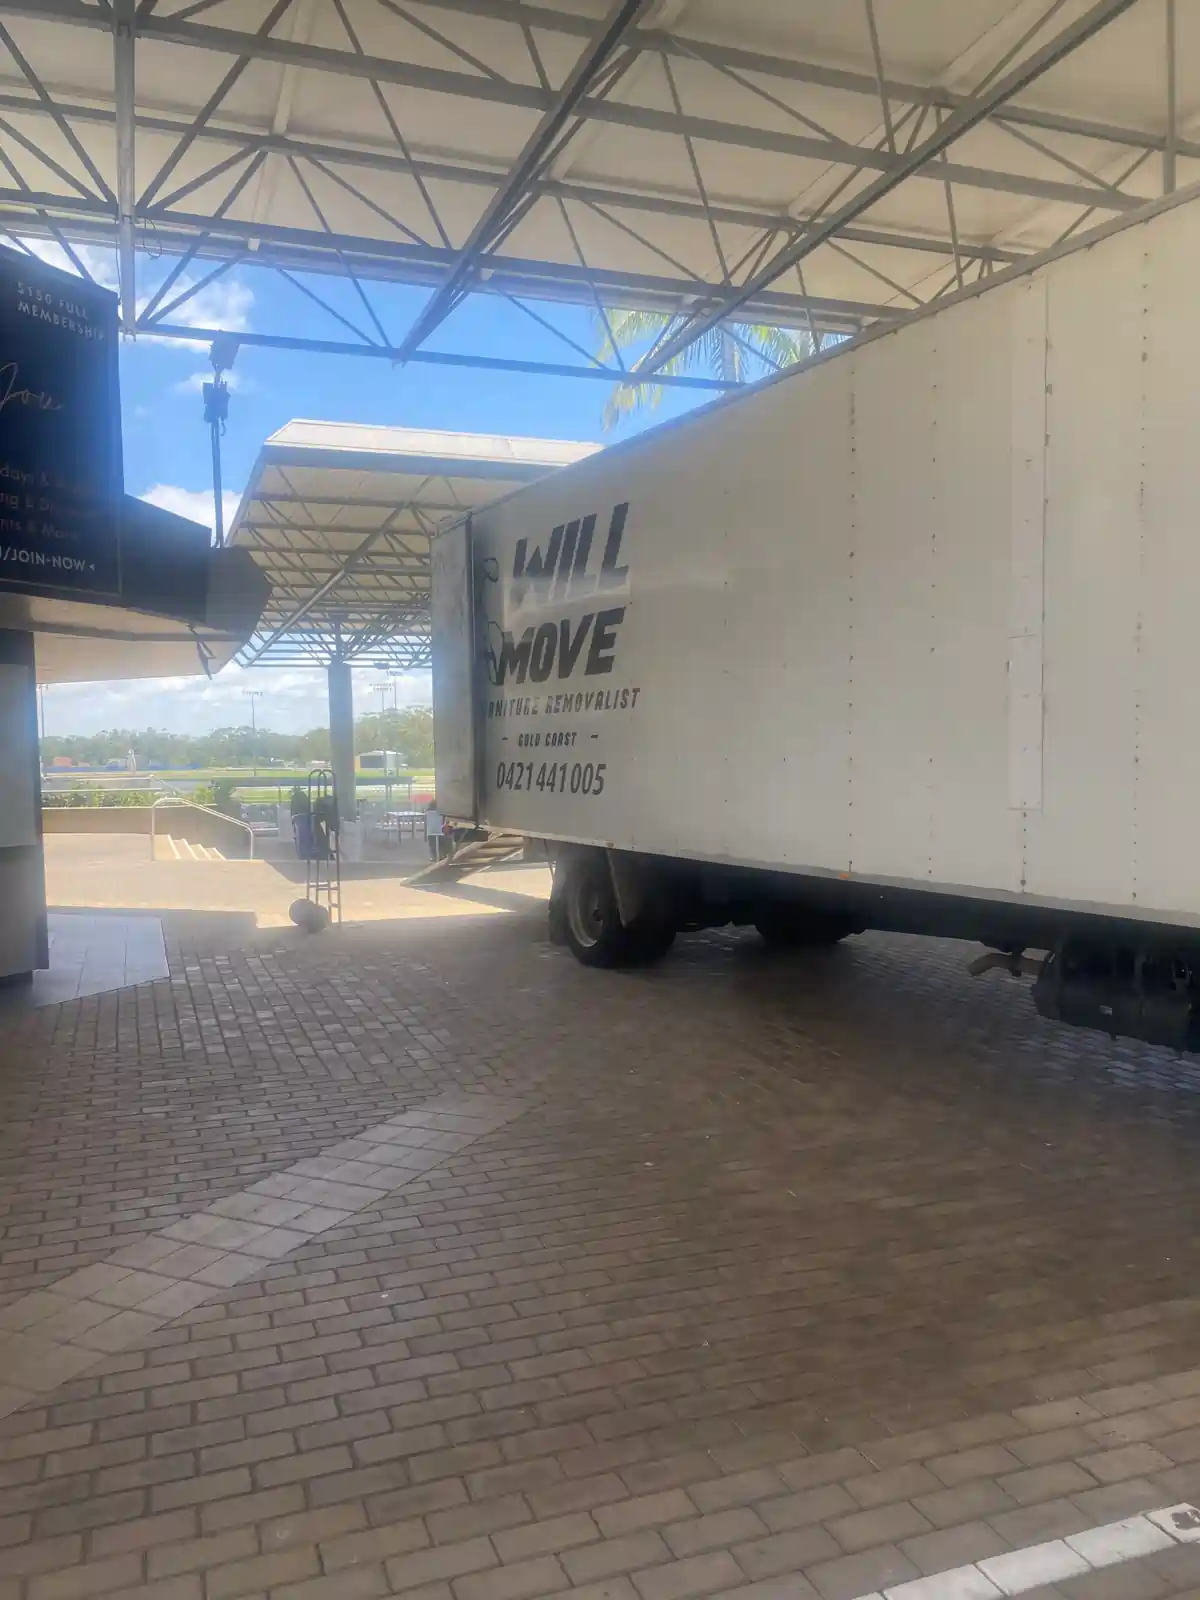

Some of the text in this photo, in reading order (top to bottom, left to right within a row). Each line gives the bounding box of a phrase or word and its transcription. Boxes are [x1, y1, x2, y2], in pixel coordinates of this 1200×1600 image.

[17, 300, 106, 341] MEMBERSHIP
[59, 299, 90, 321] FULL
[511, 502, 631, 605] WILL
[494, 606, 626, 686] MOVE
[544, 687, 641, 715] REMOVALIST
[517, 730, 577, 748] GOLD COAST
